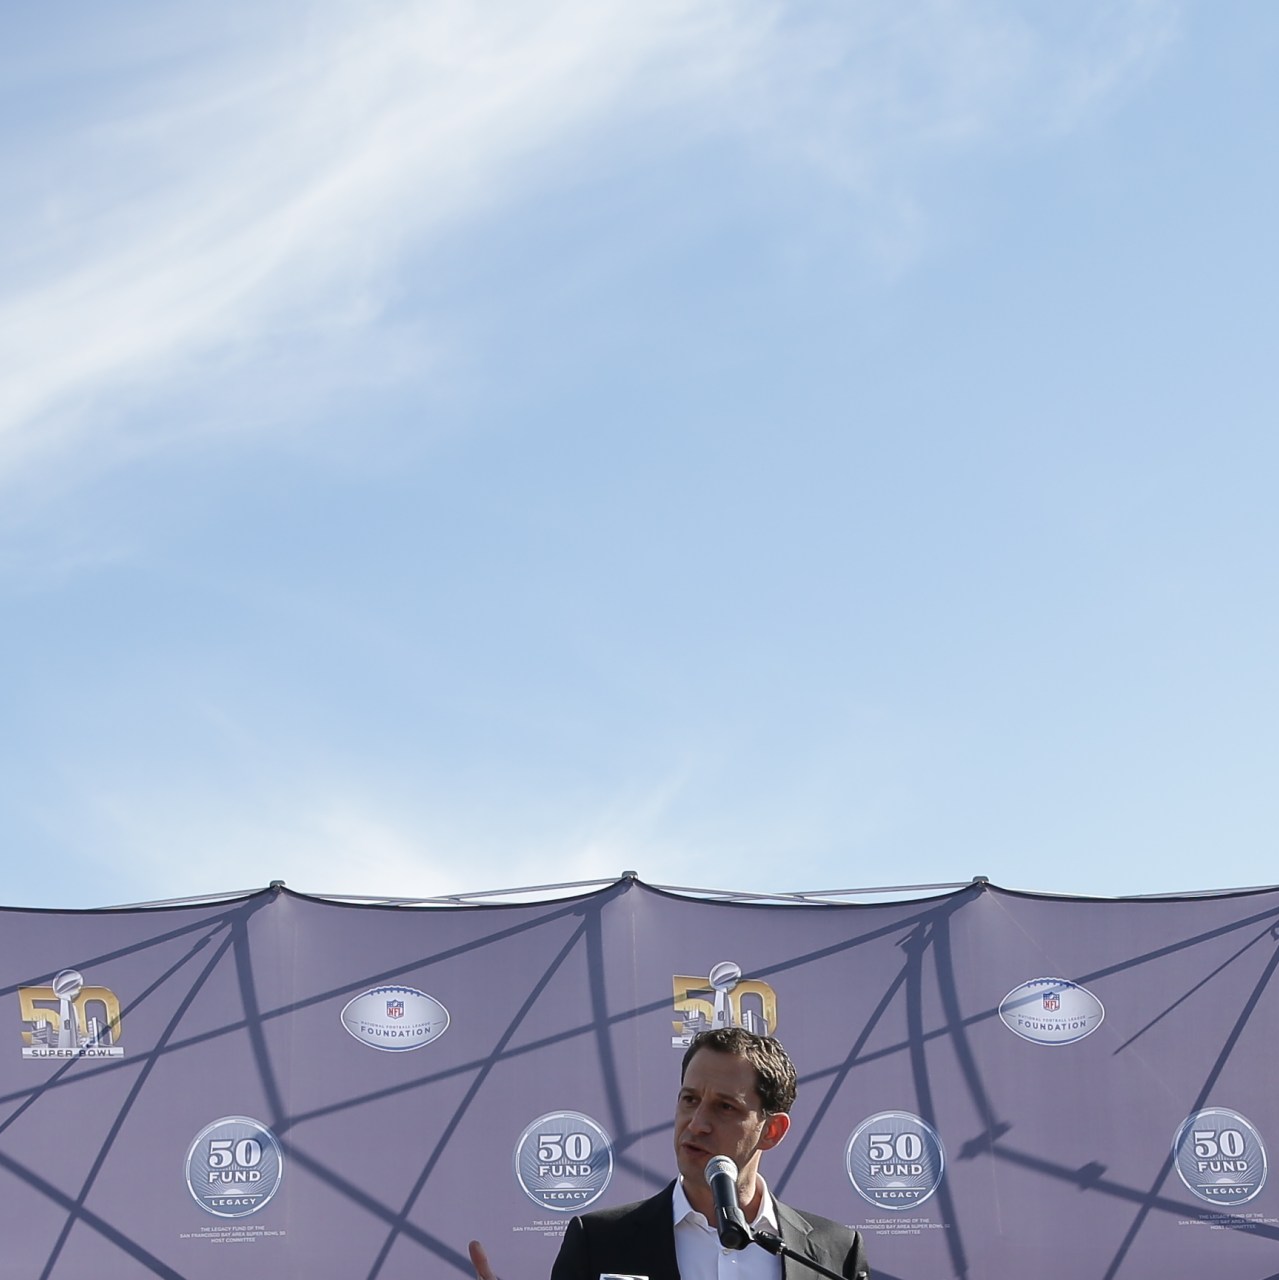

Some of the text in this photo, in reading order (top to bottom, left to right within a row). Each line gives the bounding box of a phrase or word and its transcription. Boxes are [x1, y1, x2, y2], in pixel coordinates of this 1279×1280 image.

[672, 975, 777, 1036] 50
[1045, 1000, 1058, 1009] NFL
[17, 985, 121, 1047] 50
[388, 1007, 403, 1017] NFL
[1018, 1019, 1086, 1031] FOUNDATION
[360, 1026, 431, 1038] FOUNDATION
[32, 1049, 114, 1057] SUPER BOWL
[539, 1134, 591, 1162] 50
[869, 1133, 922, 1161] 50
[1194, 1130, 1245, 1158] 50
[209, 1139, 262, 1168] 50
[539, 1165, 592, 1177] FUND
[870, 1164, 923, 1176] FUND
[1197, 1161, 1248, 1172] FUND
[209, 1171, 261, 1183] FUND
[212, 1198, 256, 1206] LEGACY
